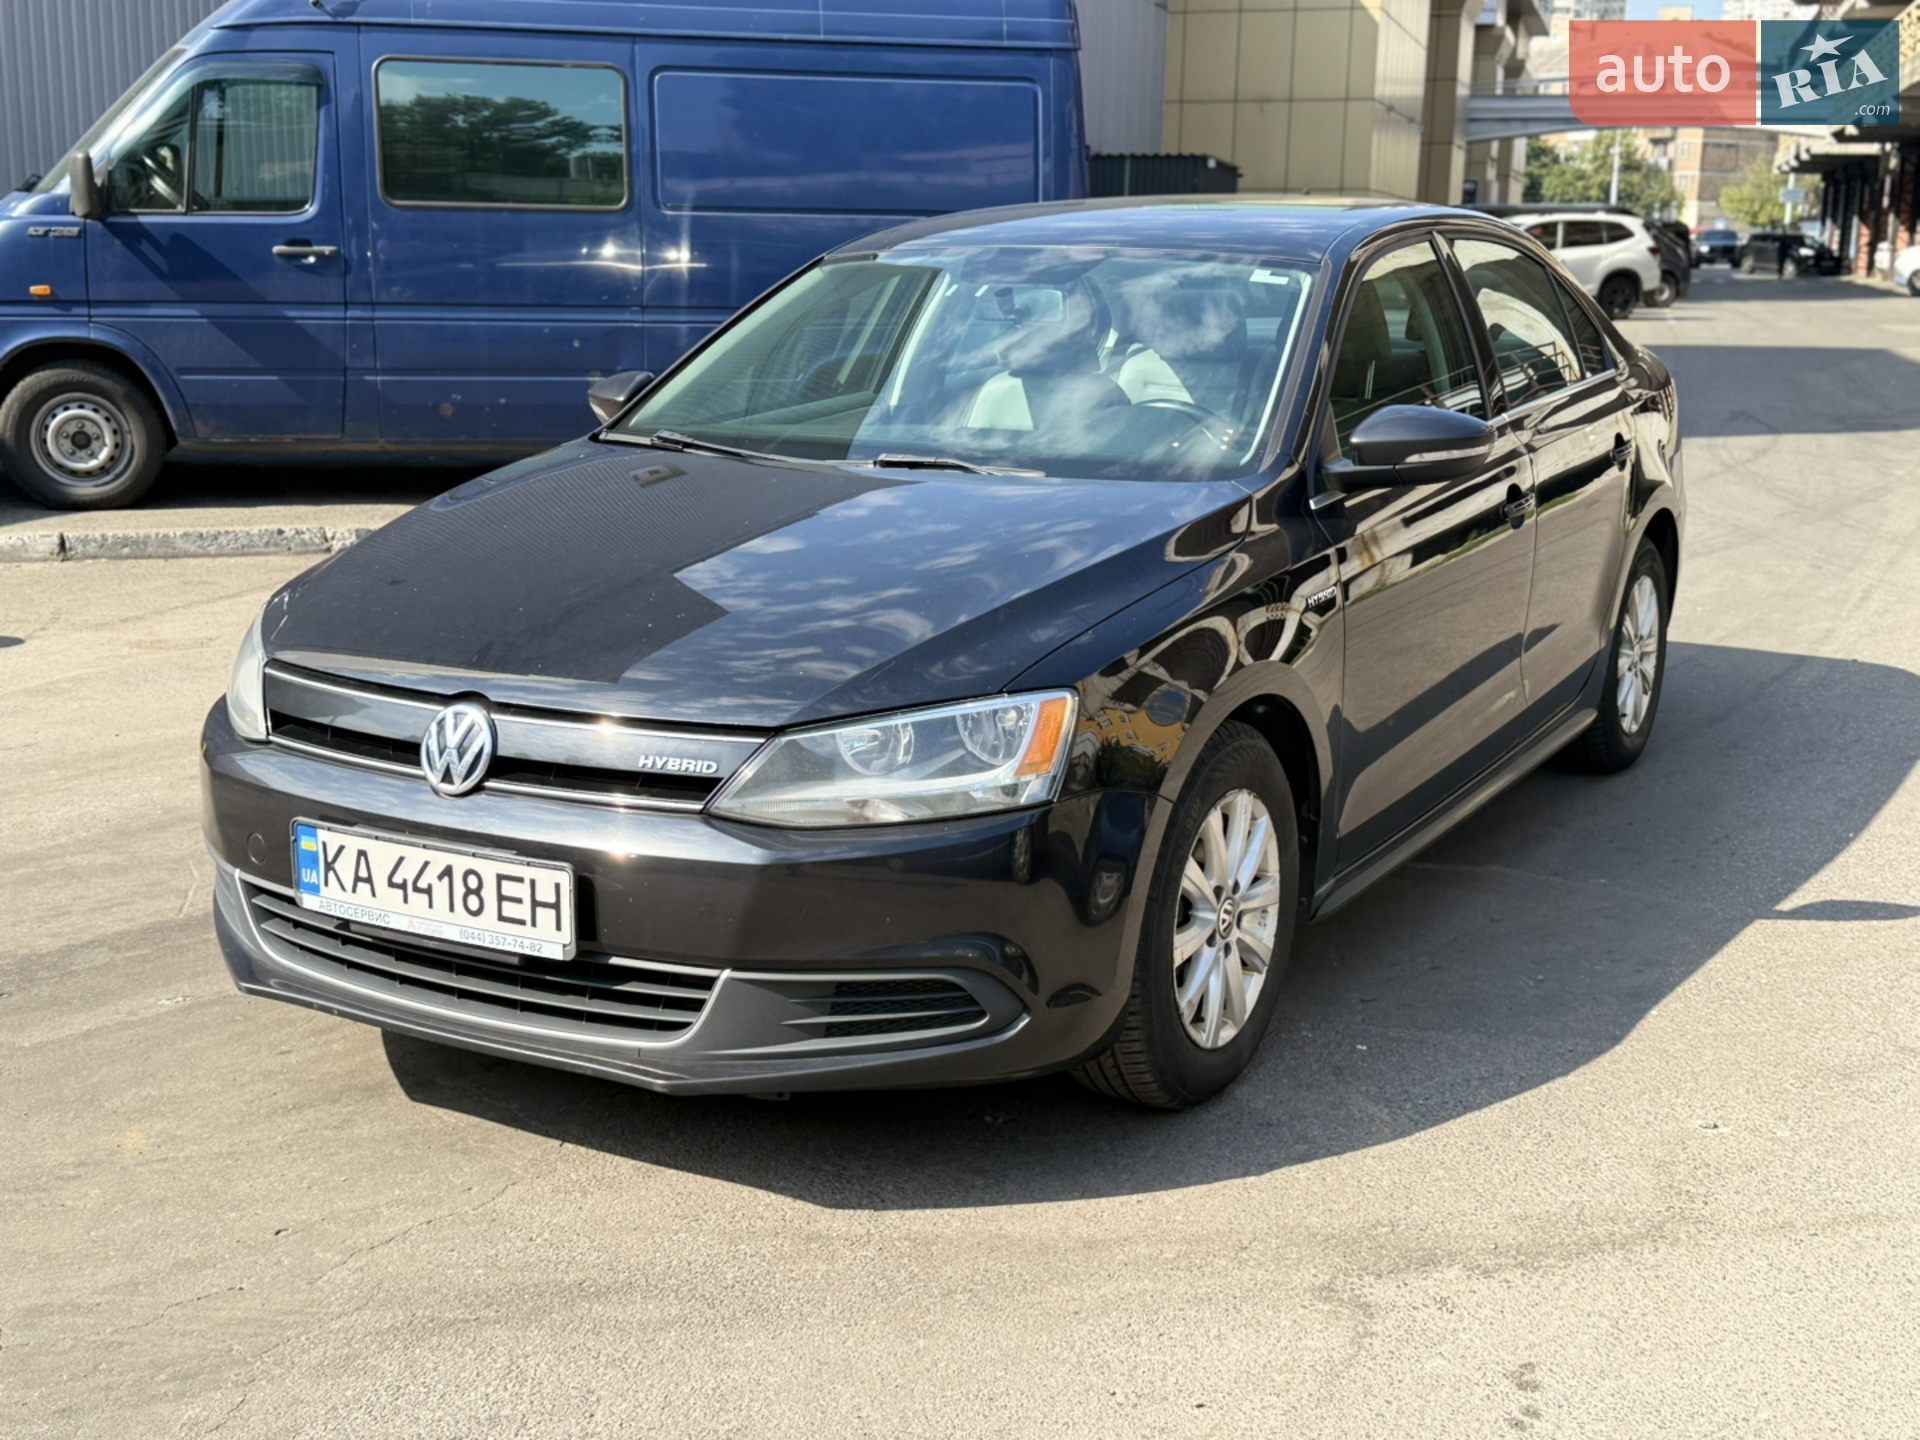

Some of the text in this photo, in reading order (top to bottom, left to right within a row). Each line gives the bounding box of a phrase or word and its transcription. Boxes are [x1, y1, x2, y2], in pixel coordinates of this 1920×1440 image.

[637, 755, 719, 775] HYBRID
[301, 867, 319, 885] UA
[321, 840, 562, 932] KA 4418 EH
[318, 899, 543, 954] АВТОСЕРВИС (044) 357-74-82
